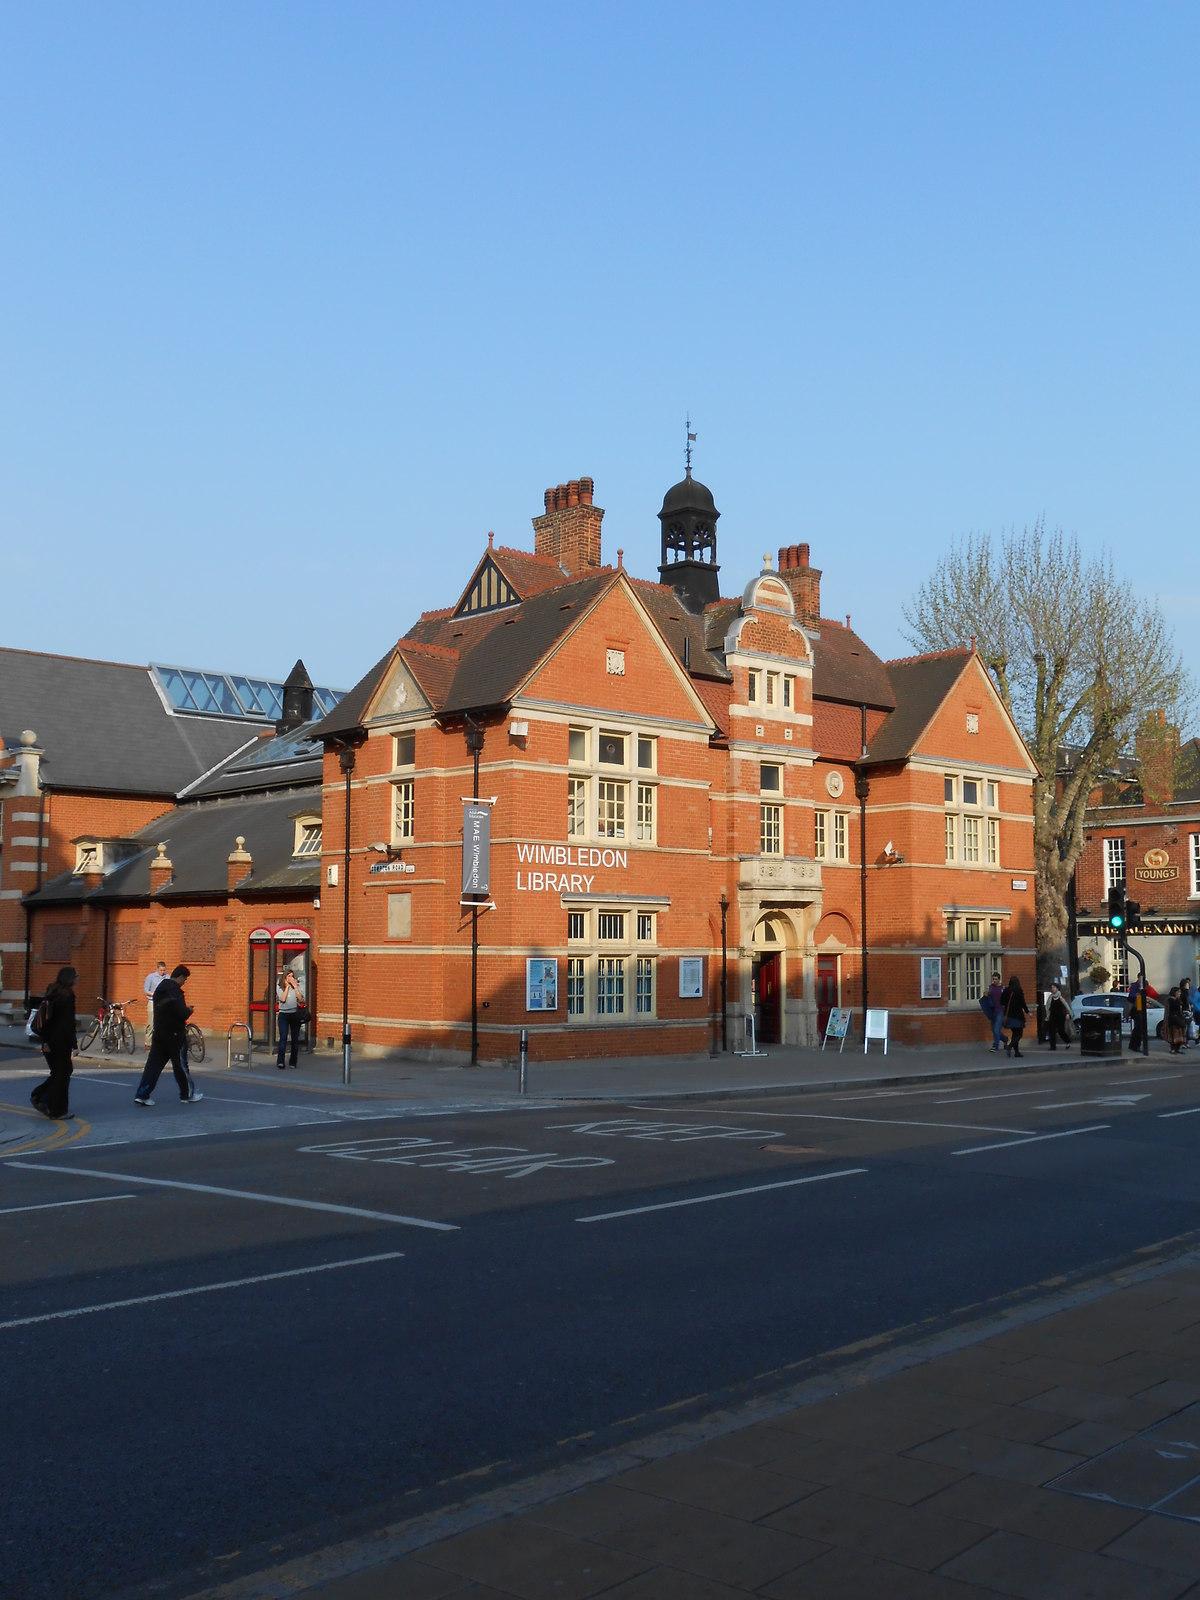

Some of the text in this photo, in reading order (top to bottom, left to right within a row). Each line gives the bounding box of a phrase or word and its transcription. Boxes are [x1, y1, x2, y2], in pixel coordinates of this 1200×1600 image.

[472, 844, 480, 889] Wimbledon
[517, 844, 627, 869] WIMBLEDON
[516, 871, 595, 893] LIBRARY
[1138, 868, 1176, 879] YOUNG'S
[544, 1118, 786, 1142] KEEP
[297, 1137, 616, 1179] CLEAR
